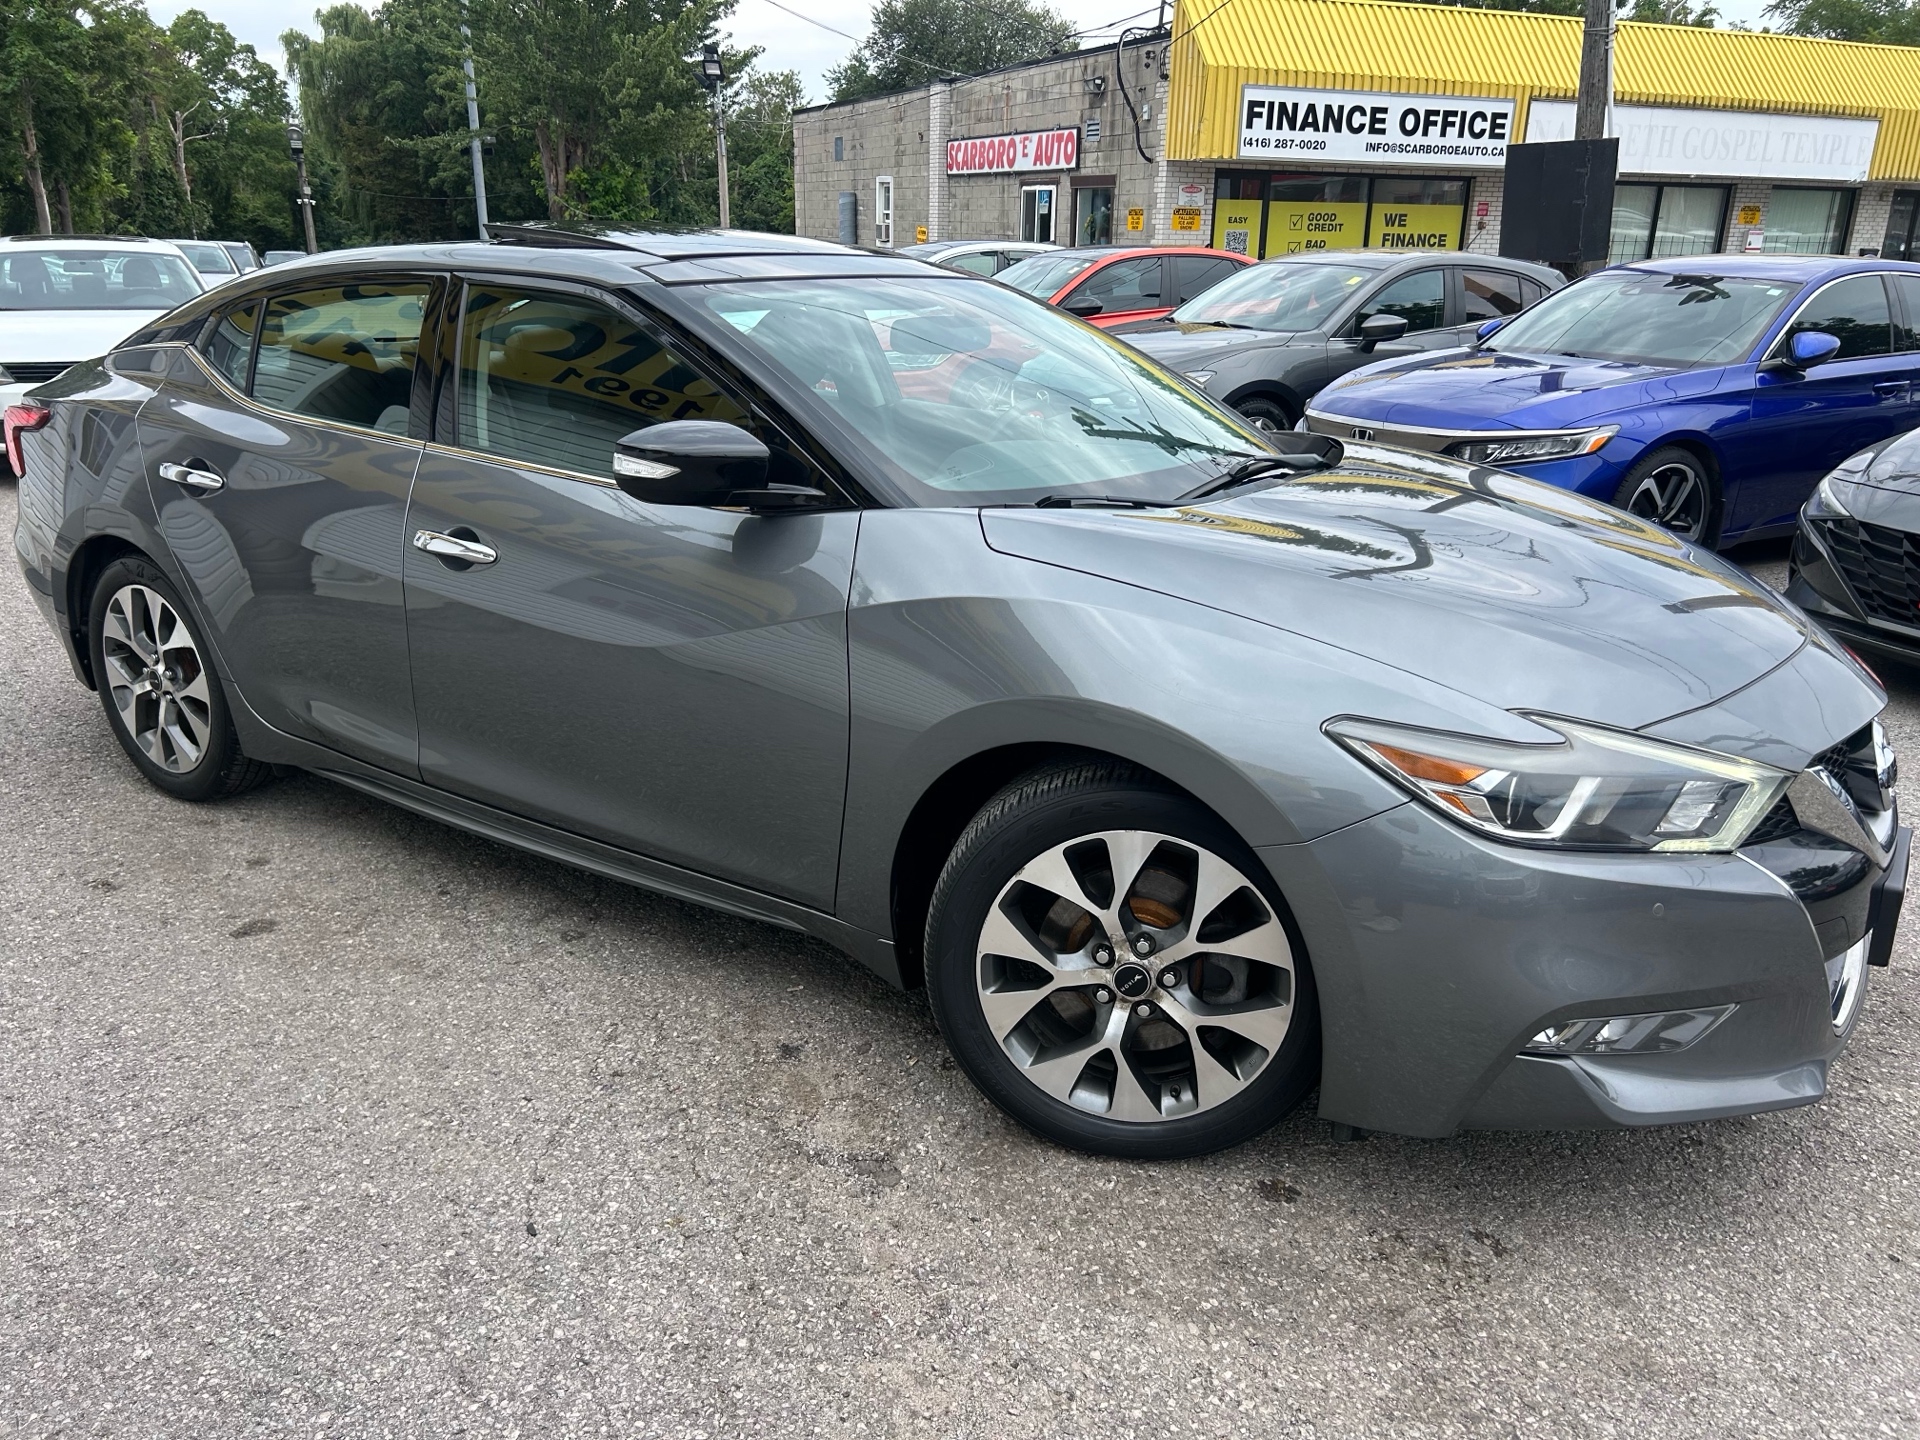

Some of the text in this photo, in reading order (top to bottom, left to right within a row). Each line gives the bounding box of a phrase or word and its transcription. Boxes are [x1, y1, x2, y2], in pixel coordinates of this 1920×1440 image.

[1245, 99, 1509, 140] FINANCE OFFICE
[1243, 136, 1327, 151] (416) 287-0020
[1365, 142, 1505, 157] INFO@SCARBOROEAUTO.CA
[1533, 118, 1870, 167] NAETH GOSPEL TEMPLE
[947, 138, 1017, 172] SCARBORO
[1033, 130, 1076, 167] AUTO
[1227, 216, 1249, 224] EASY
[1307, 212, 1337, 222] GOOD
[1384, 212, 1408, 228] WE
[1306, 222, 1344, 232] CREDIT
[1304, 239, 1327, 249] BAD
[1381, 232, 1448, 248] FINANCE
